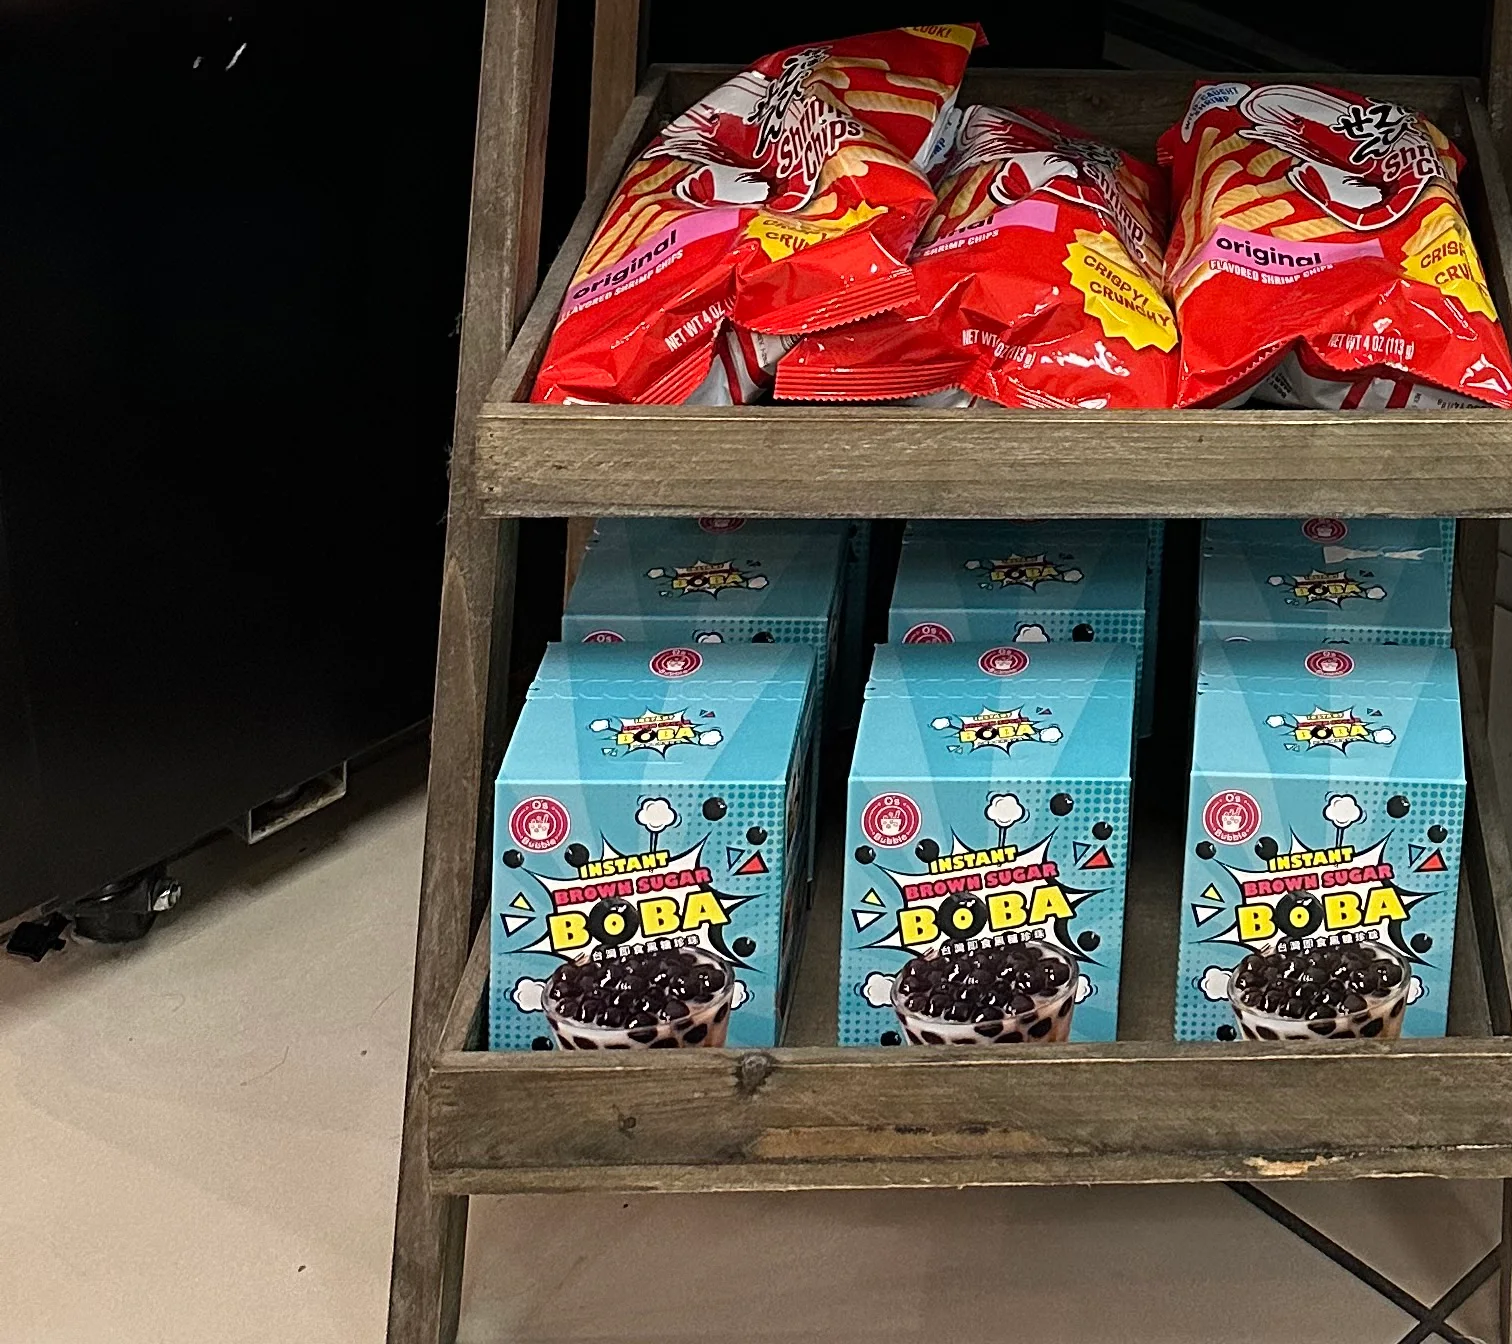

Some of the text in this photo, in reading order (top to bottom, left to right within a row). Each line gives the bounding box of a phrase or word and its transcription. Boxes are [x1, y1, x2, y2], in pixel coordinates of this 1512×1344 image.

[803, 119, 862, 182] Chips
[923, 238, 966, 258] SHRIMP
[967, 229, 999, 246] CHIPS
[1215, 237, 1322, 268] original
[572, 230, 677, 300] original
[614, 269, 655, 296] SHRIMP
[655, 249, 685, 274] CHIPS
[1210, 259, 1260, 282] FLAVORED
[1261, 271, 1301, 286] SHRIMP
[664, 300, 726, 352] NET WT 4 OZ
[962, 329, 979, 346] NET
[980, 330, 998, 347] WT
[994, 340, 1007, 359] OZ
[1327, 333, 1346, 349] NET
[1346, 334, 1363, 353] WT
[1363, 335, 1370, 349] 4
[1371, 335, 1385, 353] OZ
[1385, 337, 1405, 355] (113
[616, 726, 697, 746] BOBA
[958, 723, 1038, 743] BOBA
[1294, 723, 1370, 742] BOBA
[521, 838, 558, 851] Bubble
[872, 832, 909, 845] Bubble
[1213, 828, 1248, 842] Bubble
[580, 851, 670, 879] INSTANT
[930, 846, 1018, 874] INSTANT
[1268, 846, 1355, 873] INSTANT
[553, 867, 712, 907] BROWN SUGAR
[904, 862, 1059, 902] BROWN SUGAR
[1243, 864, 1394, 898] BROWN SUGAR
[548, 891, 730, 951] BOBA
[898, 885, 1075, 946] BOBA
[1237, 887, 1409, 941] BOBA
